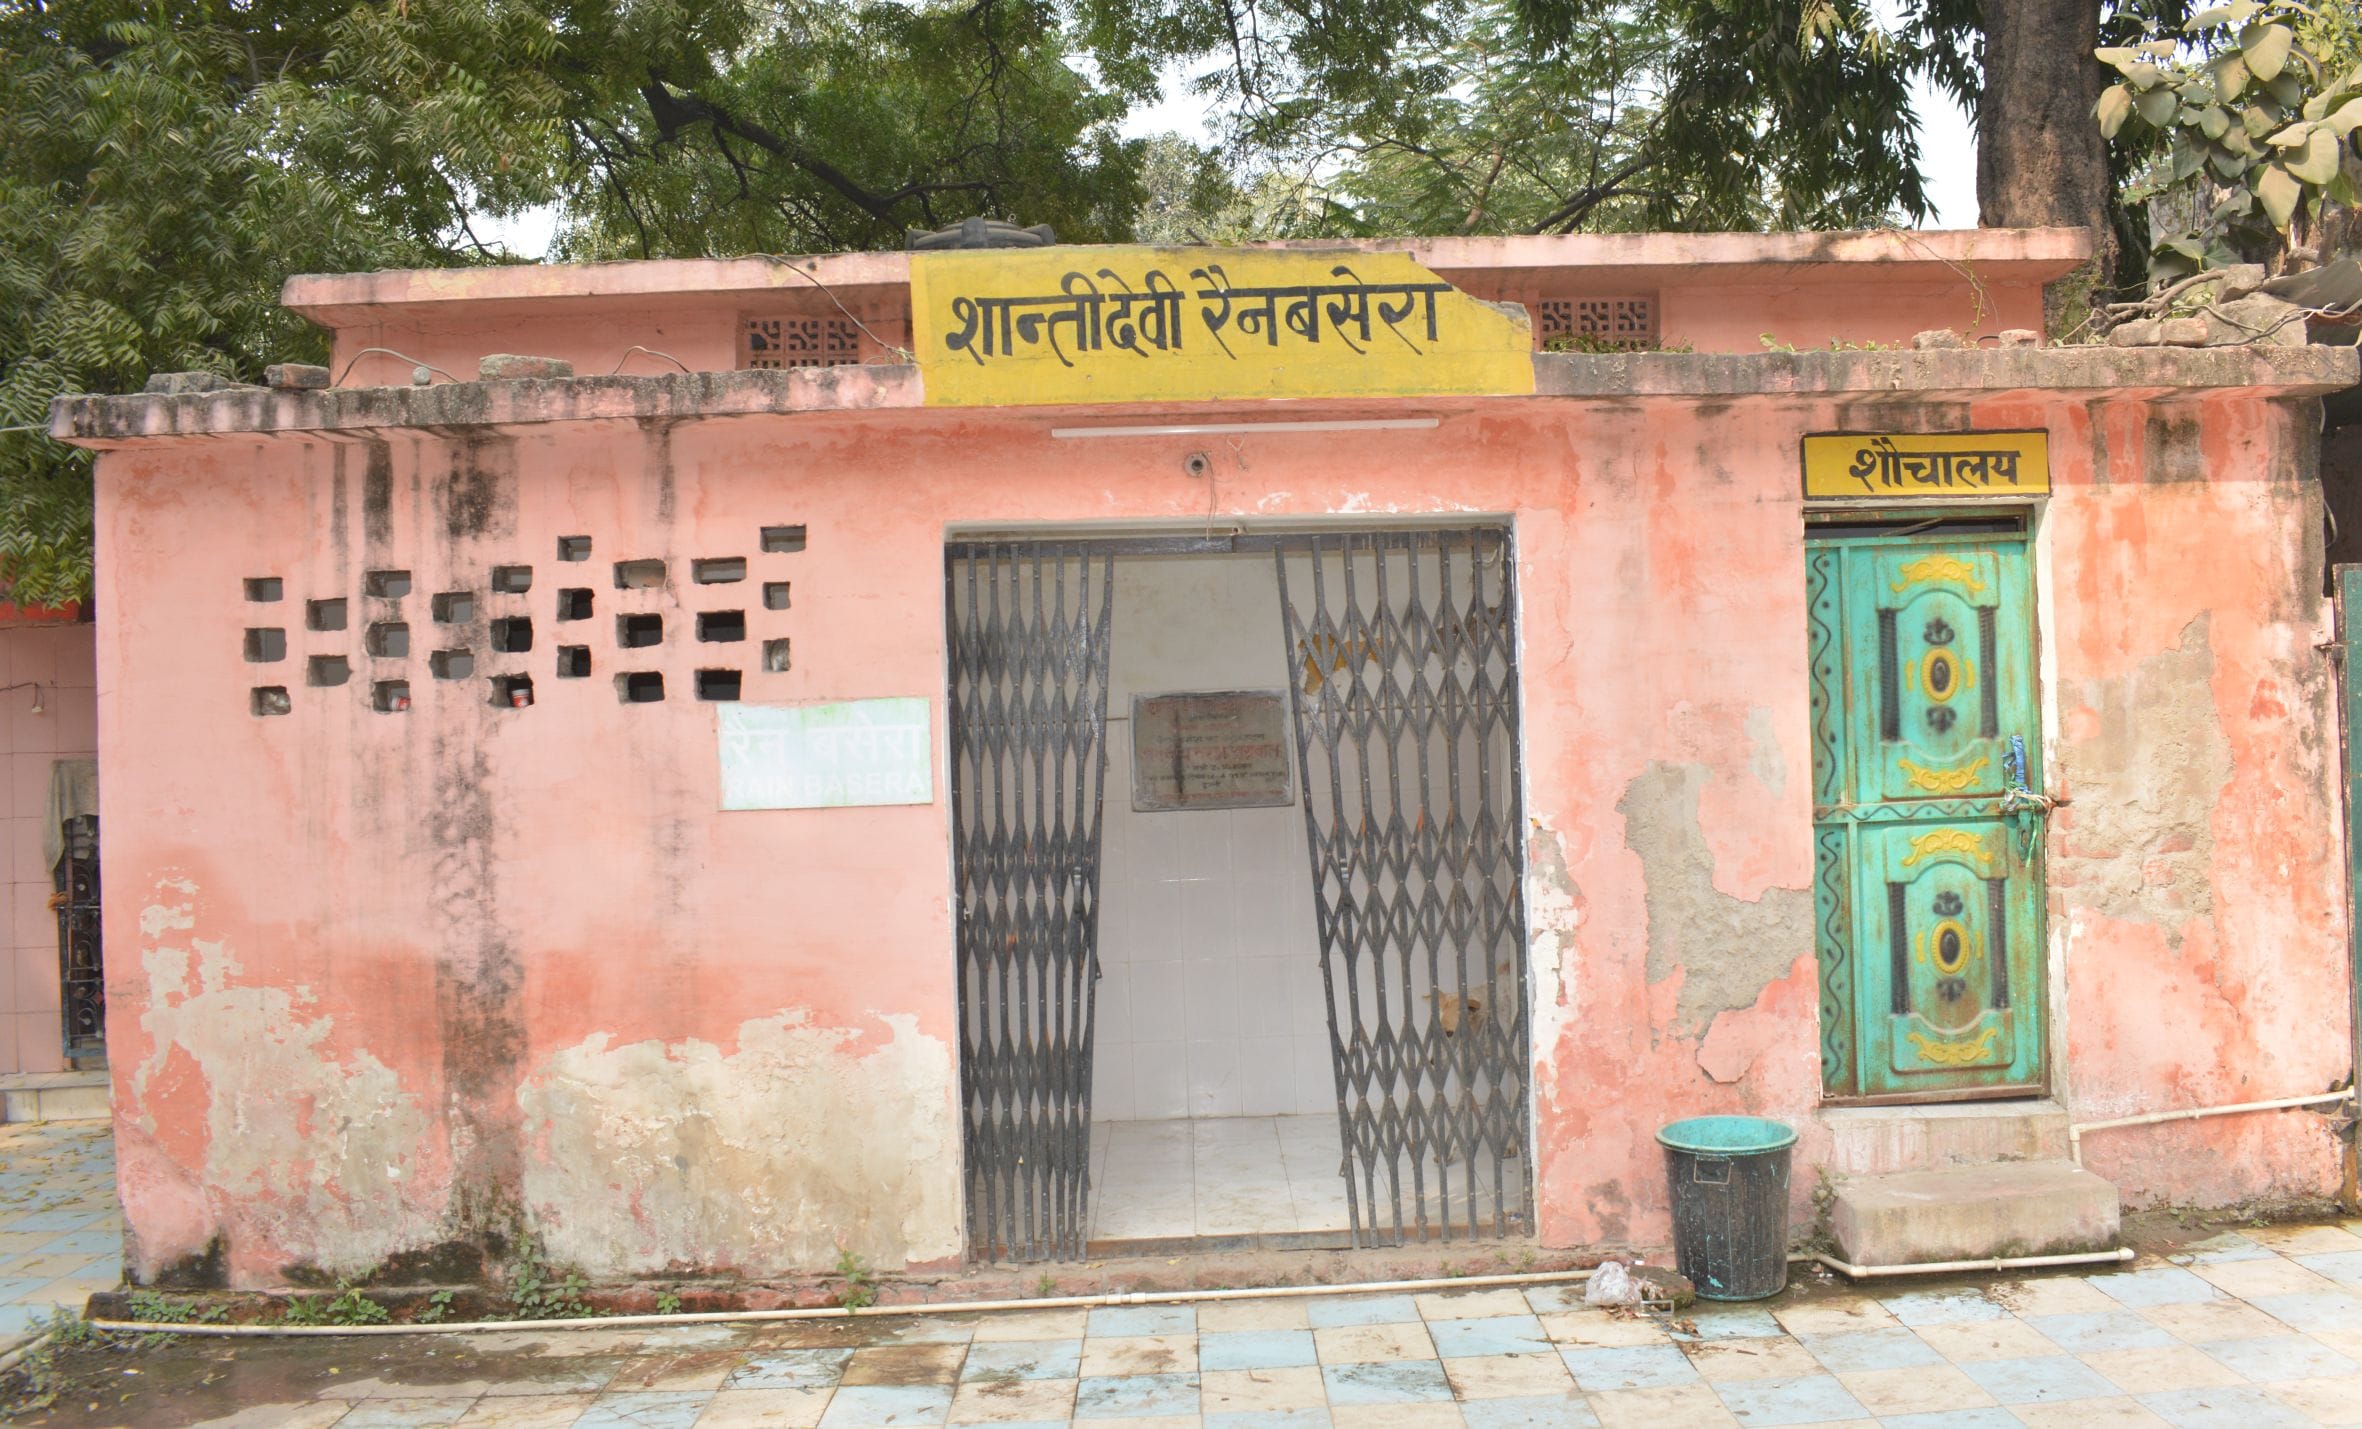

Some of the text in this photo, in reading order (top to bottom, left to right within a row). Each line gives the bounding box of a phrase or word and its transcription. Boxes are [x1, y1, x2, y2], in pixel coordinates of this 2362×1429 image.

[1849, 437, 2021, 492] शौचालय
[726, 771, 926, 798] RAIN BASERA
